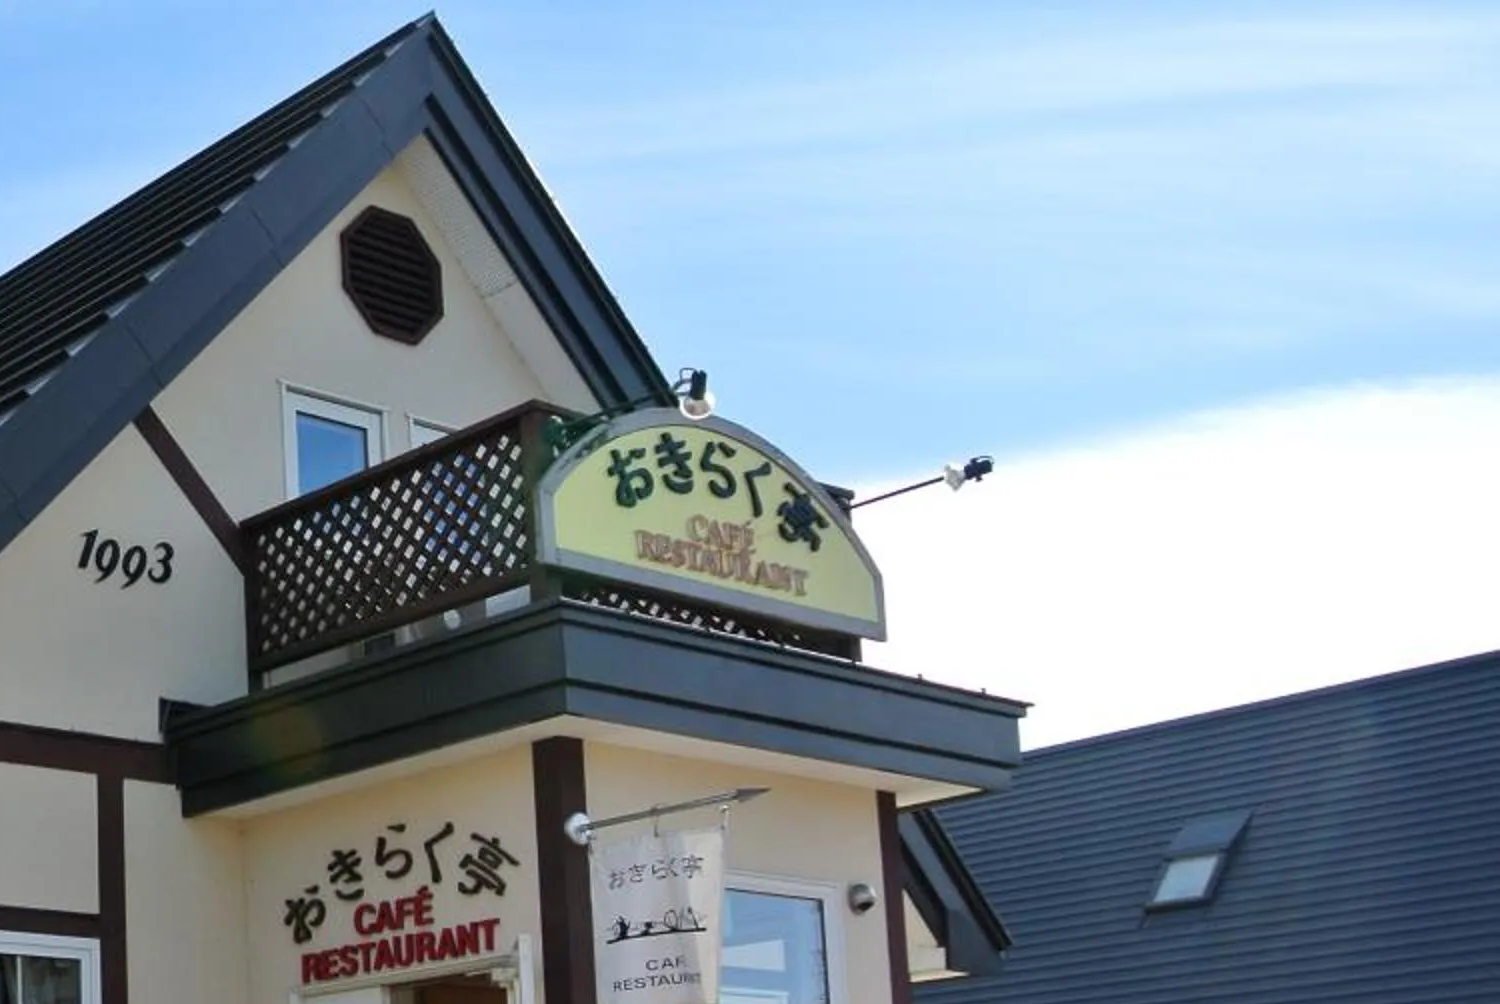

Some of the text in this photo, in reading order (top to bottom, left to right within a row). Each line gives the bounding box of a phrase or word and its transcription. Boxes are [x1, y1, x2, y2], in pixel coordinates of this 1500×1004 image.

[607, 432, 830, 552] おきらく亭
[78, 529, 174, 590] 1993
[634, 529, 809, 596] RESTAURANT
[284, 822, 520, 945] おきらく亭
[354, 885, 435, 936] CAFÉ
[302, 917, 501, 984] RESTAURANT
